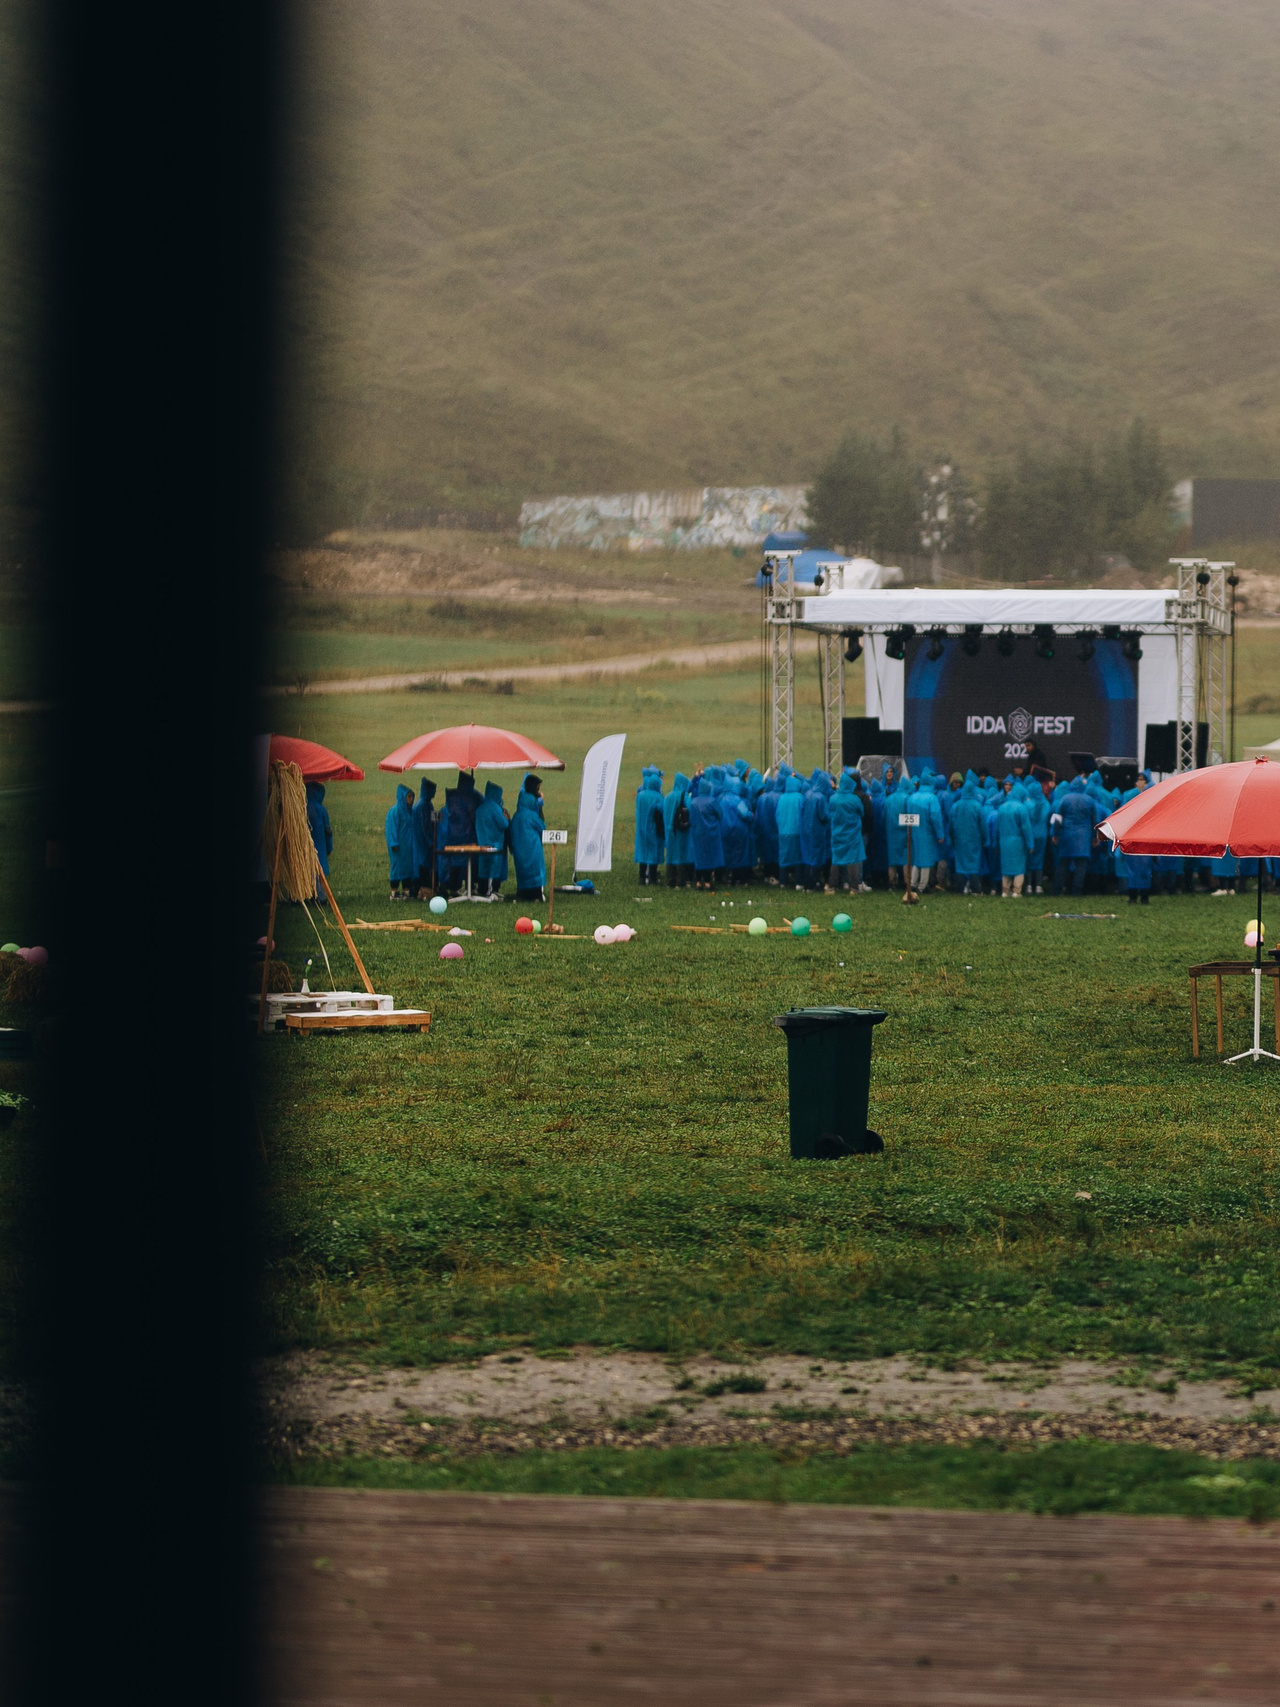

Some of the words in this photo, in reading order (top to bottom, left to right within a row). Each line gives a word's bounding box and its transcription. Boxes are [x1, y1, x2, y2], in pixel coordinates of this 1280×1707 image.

[966, 715, 1007, 734] IDDA
[1033, 715, 1075, 735] FEST
[1004, 742, 1030, 759] 202
[904, 814, 915, 824] 25
[548, 831, 561, 841] 26
